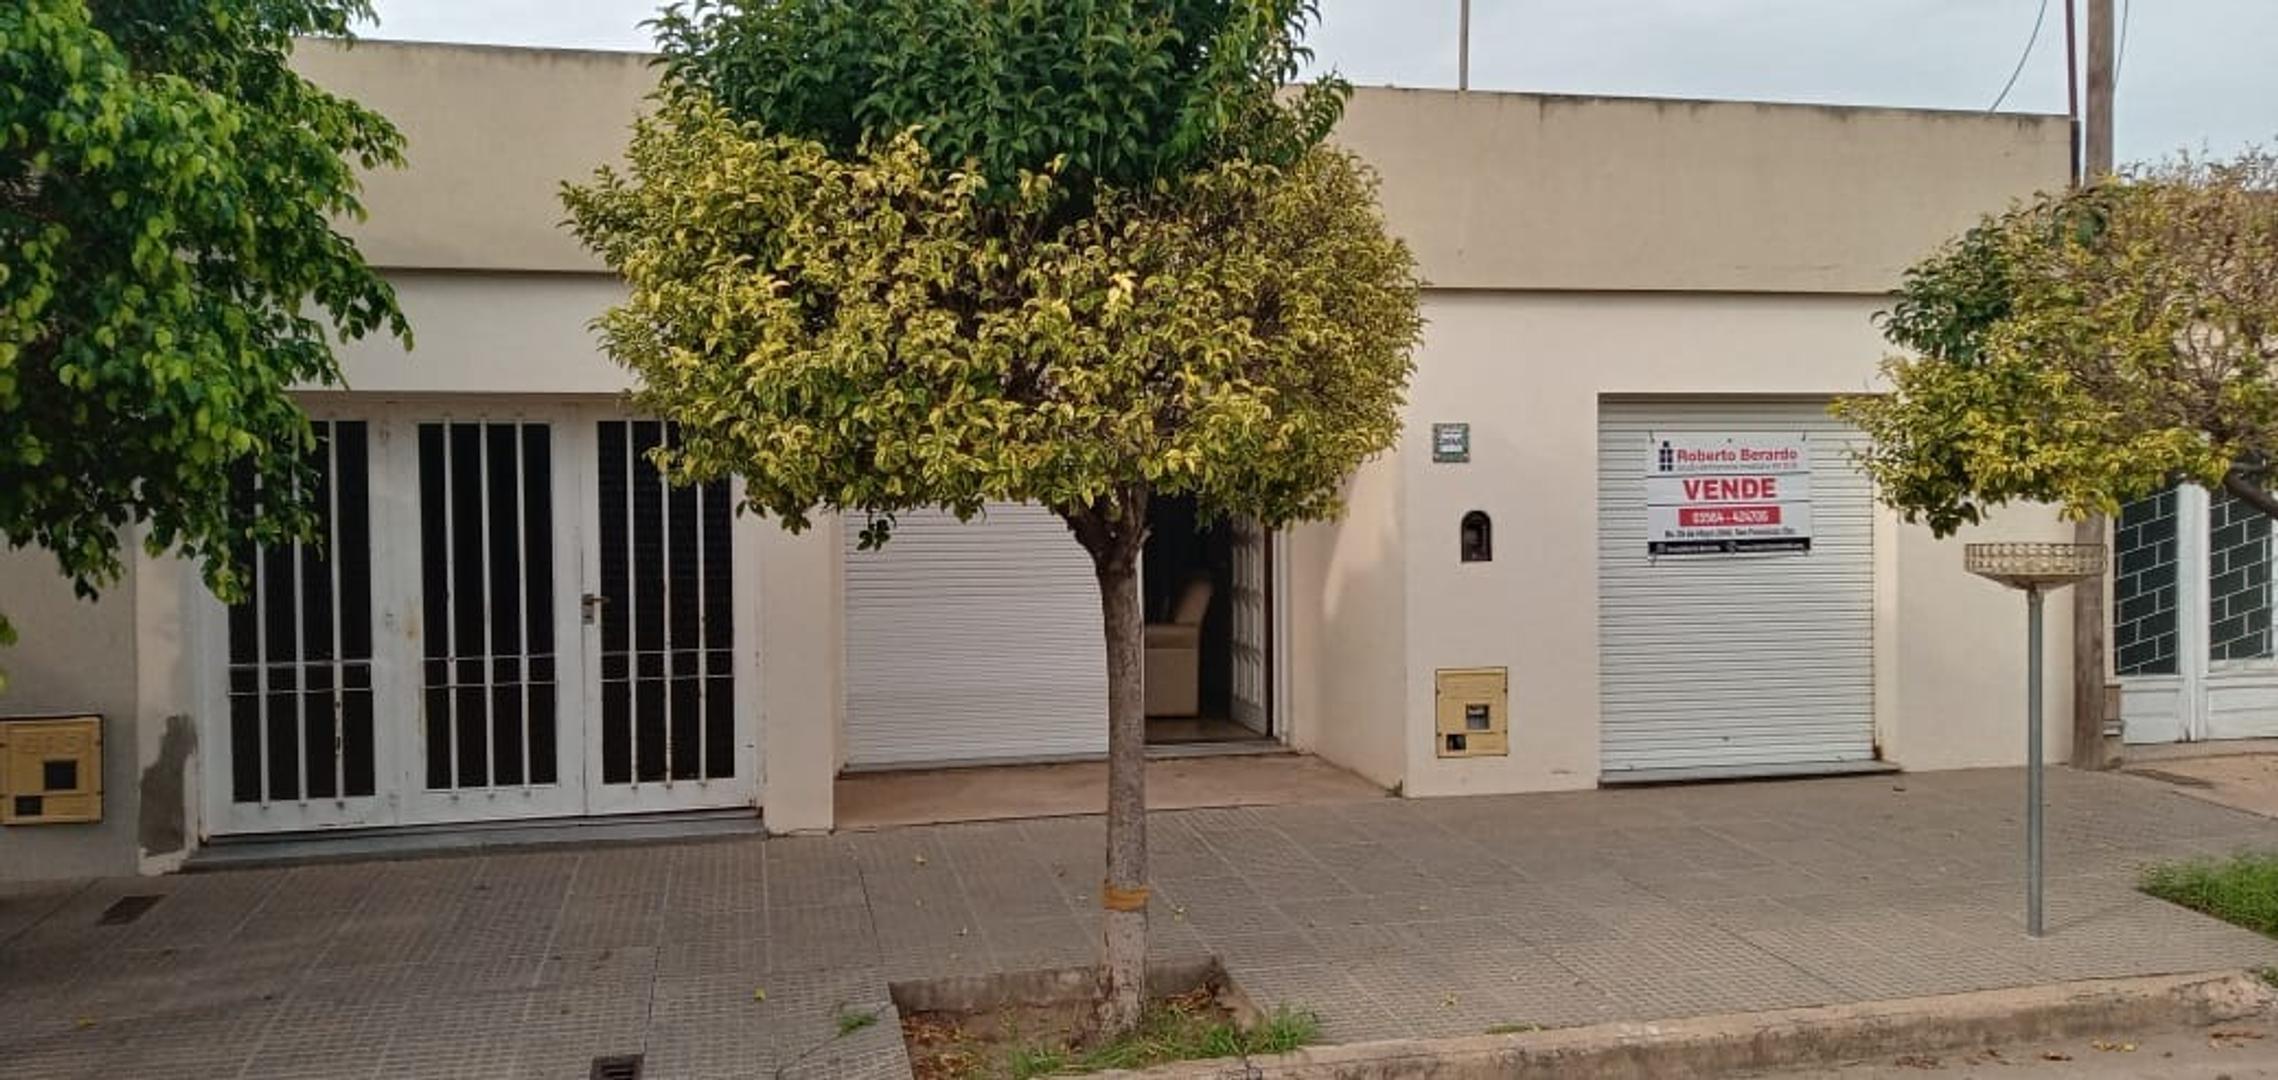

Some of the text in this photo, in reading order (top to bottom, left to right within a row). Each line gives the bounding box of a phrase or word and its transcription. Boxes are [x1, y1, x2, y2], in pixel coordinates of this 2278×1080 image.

[1677, 448, 1797, 462] Roberto Berardo
[1683, 478, 1776, 500] VENDE
